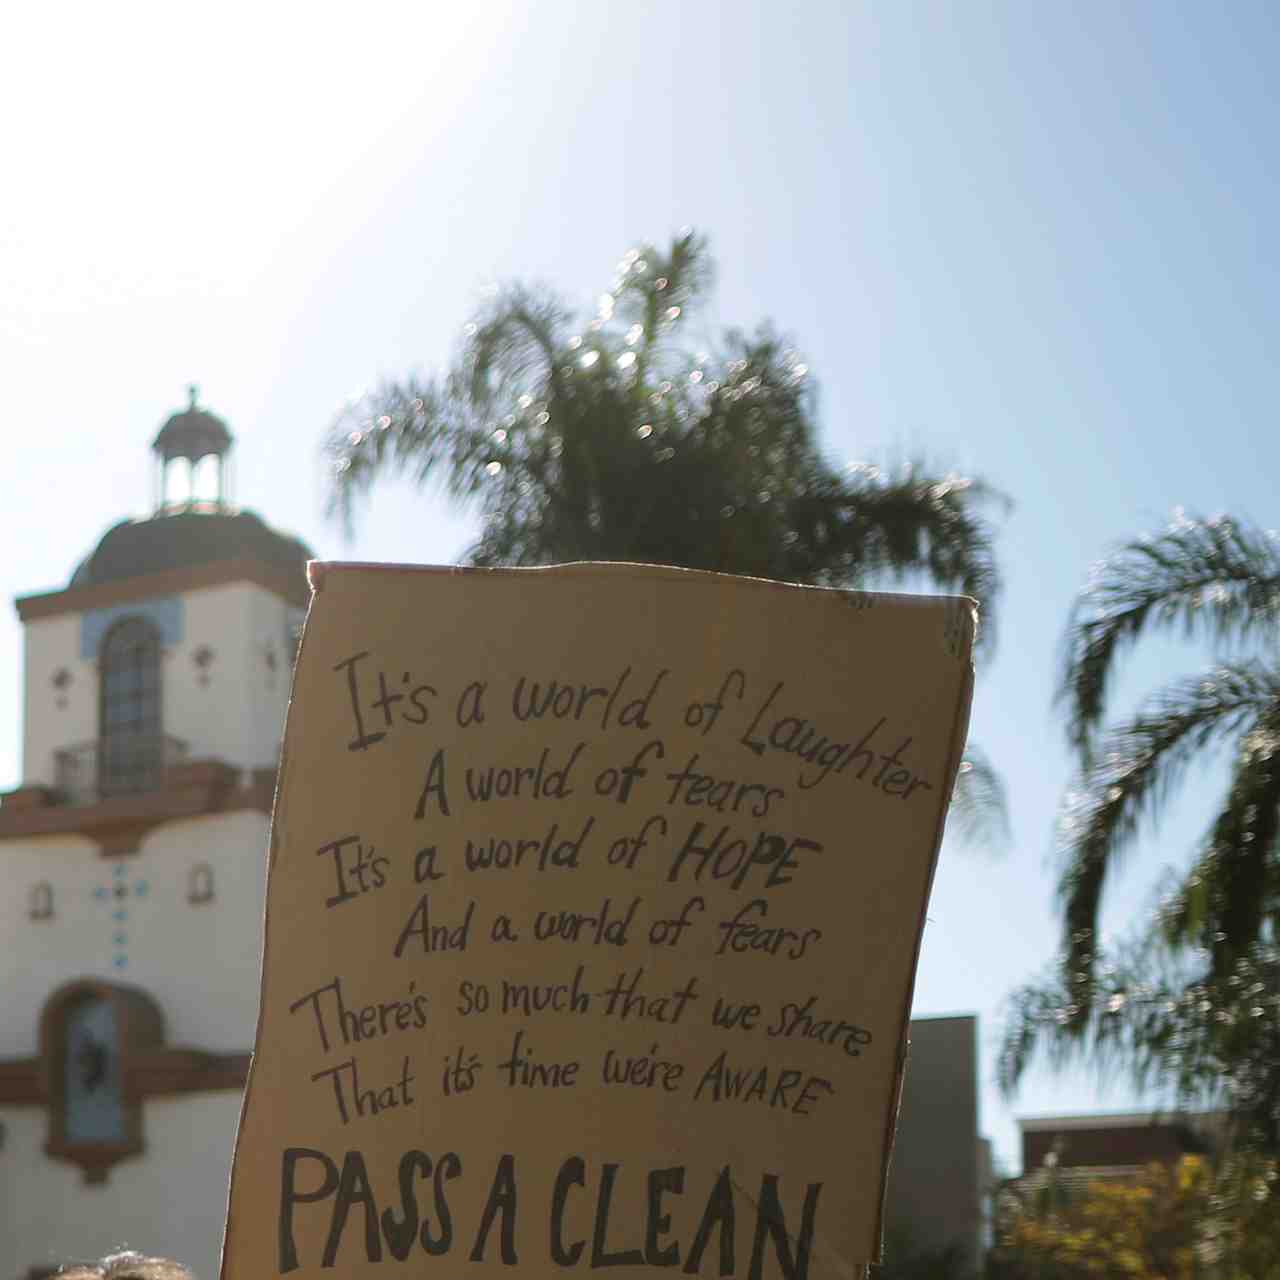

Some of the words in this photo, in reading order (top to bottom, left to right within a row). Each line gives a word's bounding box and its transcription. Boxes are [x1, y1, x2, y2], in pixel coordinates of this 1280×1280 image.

[333, 651, 438, 751] It's
[456, 679, 486, 728] a
[512, 665, 668, 731] world
[685, 669, 741, 734] of
[739, 681, 933, 802] Laughter
[414, 749, 450, 819] A
[466, 743, 586, 802] world
[595, 742, 664, 804] of
[667, 754, 785, 817] tears
[317, 835, 390, 907] It's
[414, 842, 445, 882] a
[465, 815, 596, 872] world
[607, 816, 667, 870] of
[667, 822, 824, 890] HOPE
[394, 894, 475, 958] And
[491, 914, 518, 942] a
[534, 896, 642, 947] world
[649, 896, 705, 946] of
[715, 899, 823, 960] fears
[290, 978, 427, 1054] There's
[457, 979, 490, 1014] so
[500, 965, 591, 1015] much
[592, 967, 699, 1027] that
[711, 998, 763, 1031] we
[767, 997, 873, 1058] share
[311, 1055, 415, 1127] That
[442, 1044, 483, 1097] it's
[497, 1031, 580, 1090] time
[693, 1052, 836, 1117] AWARE
[278, 1147, 462, 1274] PASS
[470, 1153, 518, 1266] A
